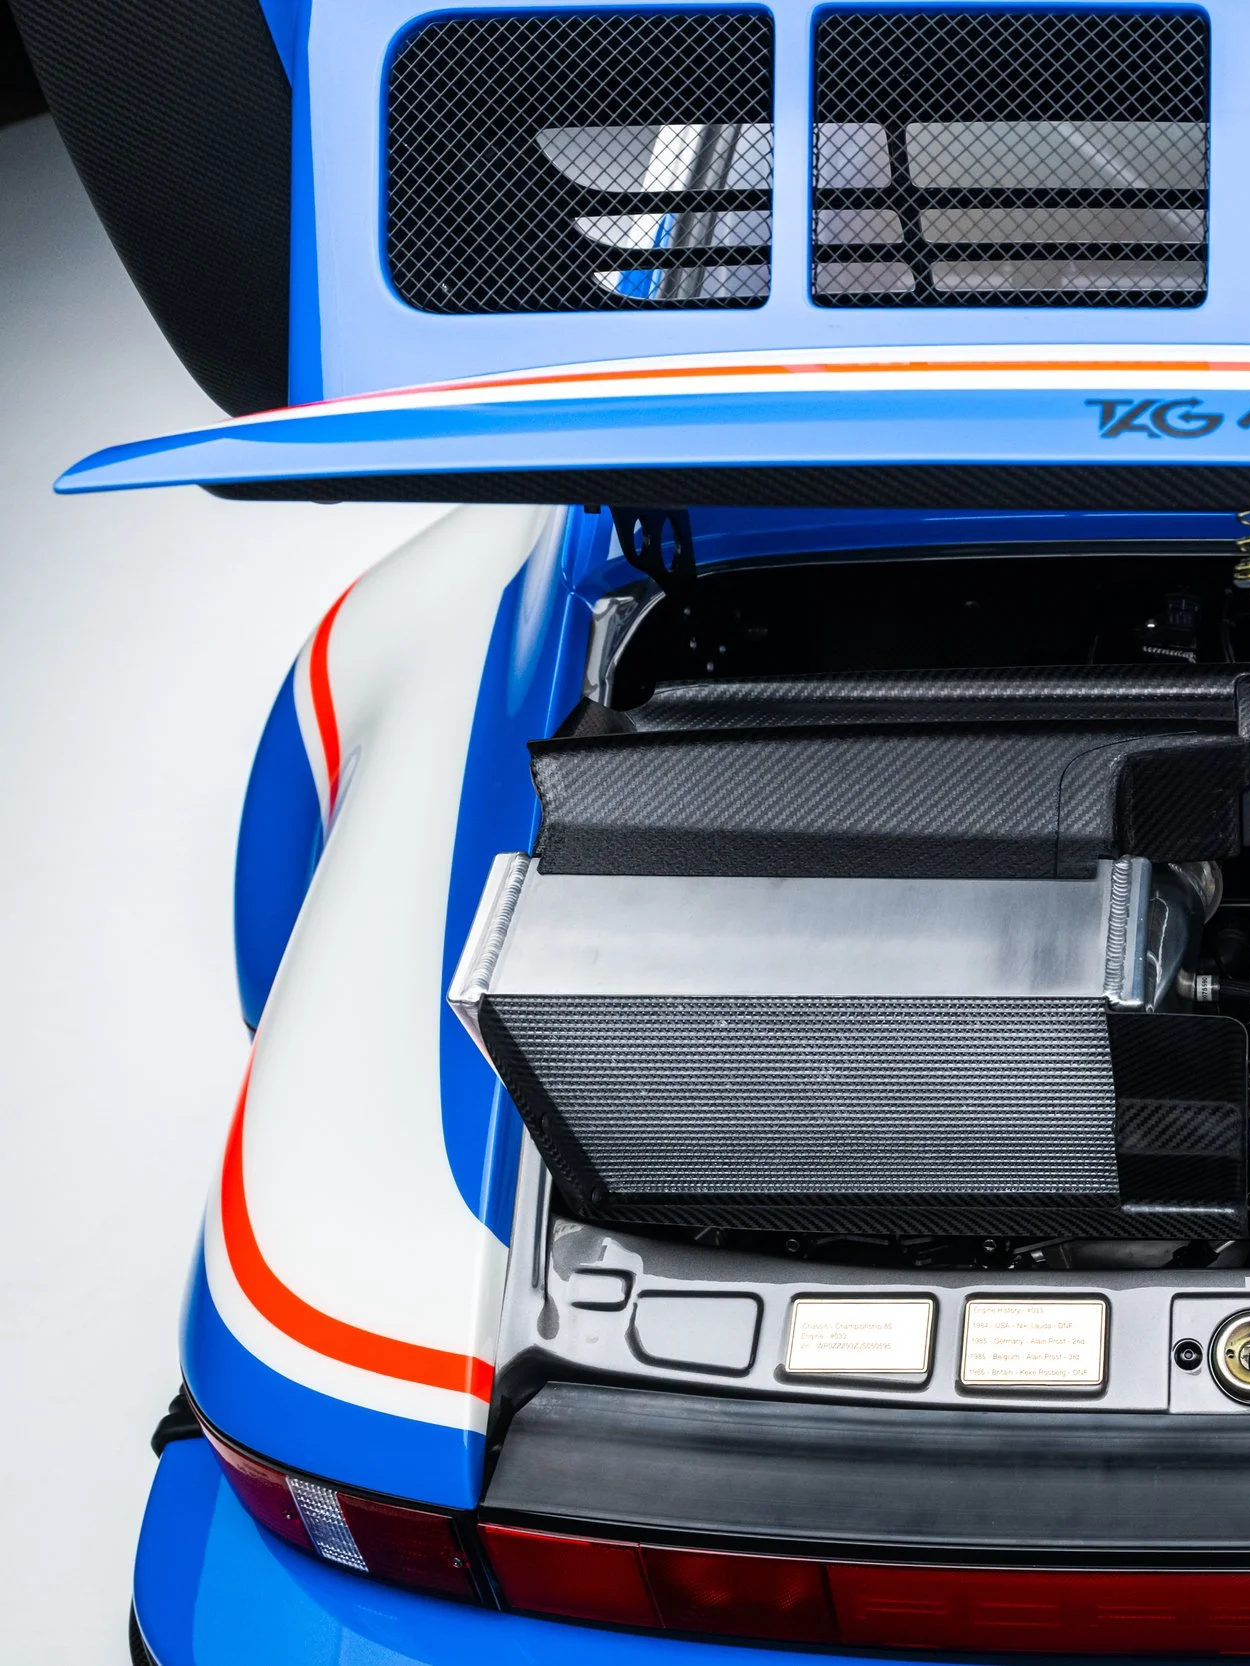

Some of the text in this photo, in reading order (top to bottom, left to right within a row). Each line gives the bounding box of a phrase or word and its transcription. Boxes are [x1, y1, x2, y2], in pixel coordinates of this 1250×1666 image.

[1084, 397, 1224, 439] TAG
[994, 1337, 1025, 1346] Germany
[993, 1353, 1020, 1362] Belgium
[1038, 1368, 1067, 1377] Rosberg
